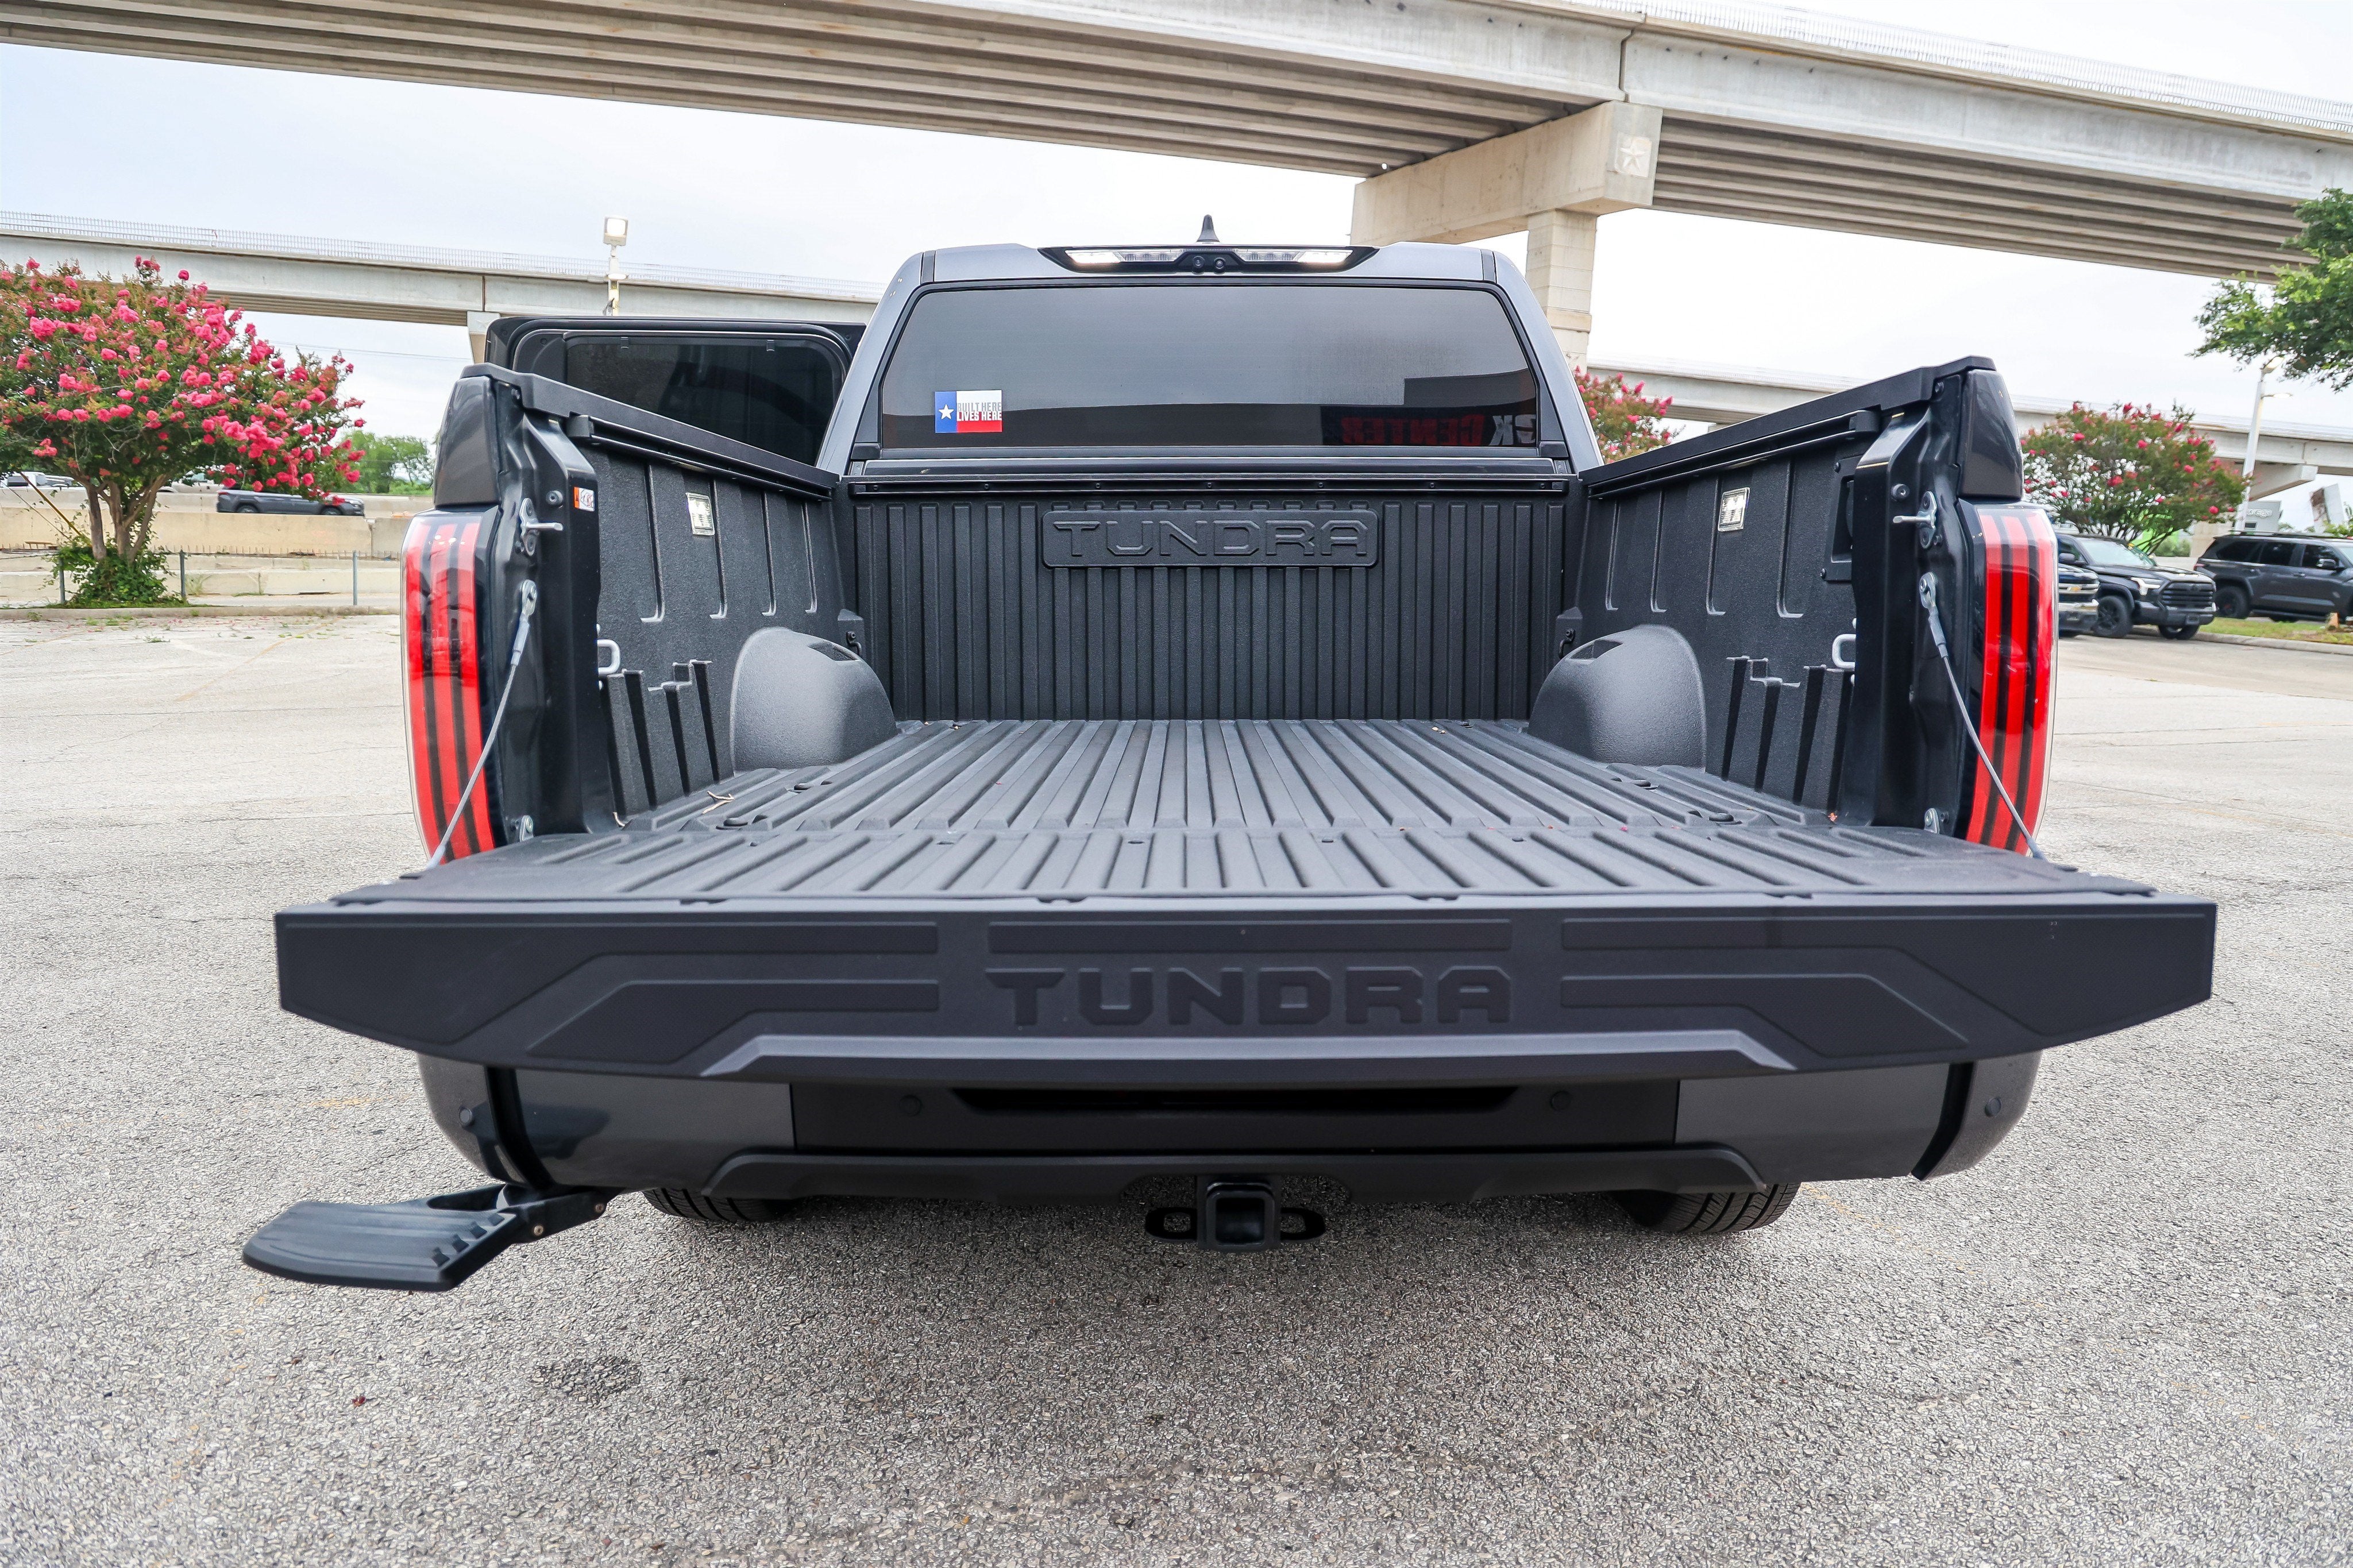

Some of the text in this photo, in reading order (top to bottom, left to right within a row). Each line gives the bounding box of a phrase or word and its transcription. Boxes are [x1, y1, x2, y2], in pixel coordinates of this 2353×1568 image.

[957, 402, 1001, 412] BUILT HERE
[957, 411, 1002, 421] LIVES HERE
[1053, 520, 1366, 556] TUNDRA
[985, 966, 1511, 1025] TUNDRA
